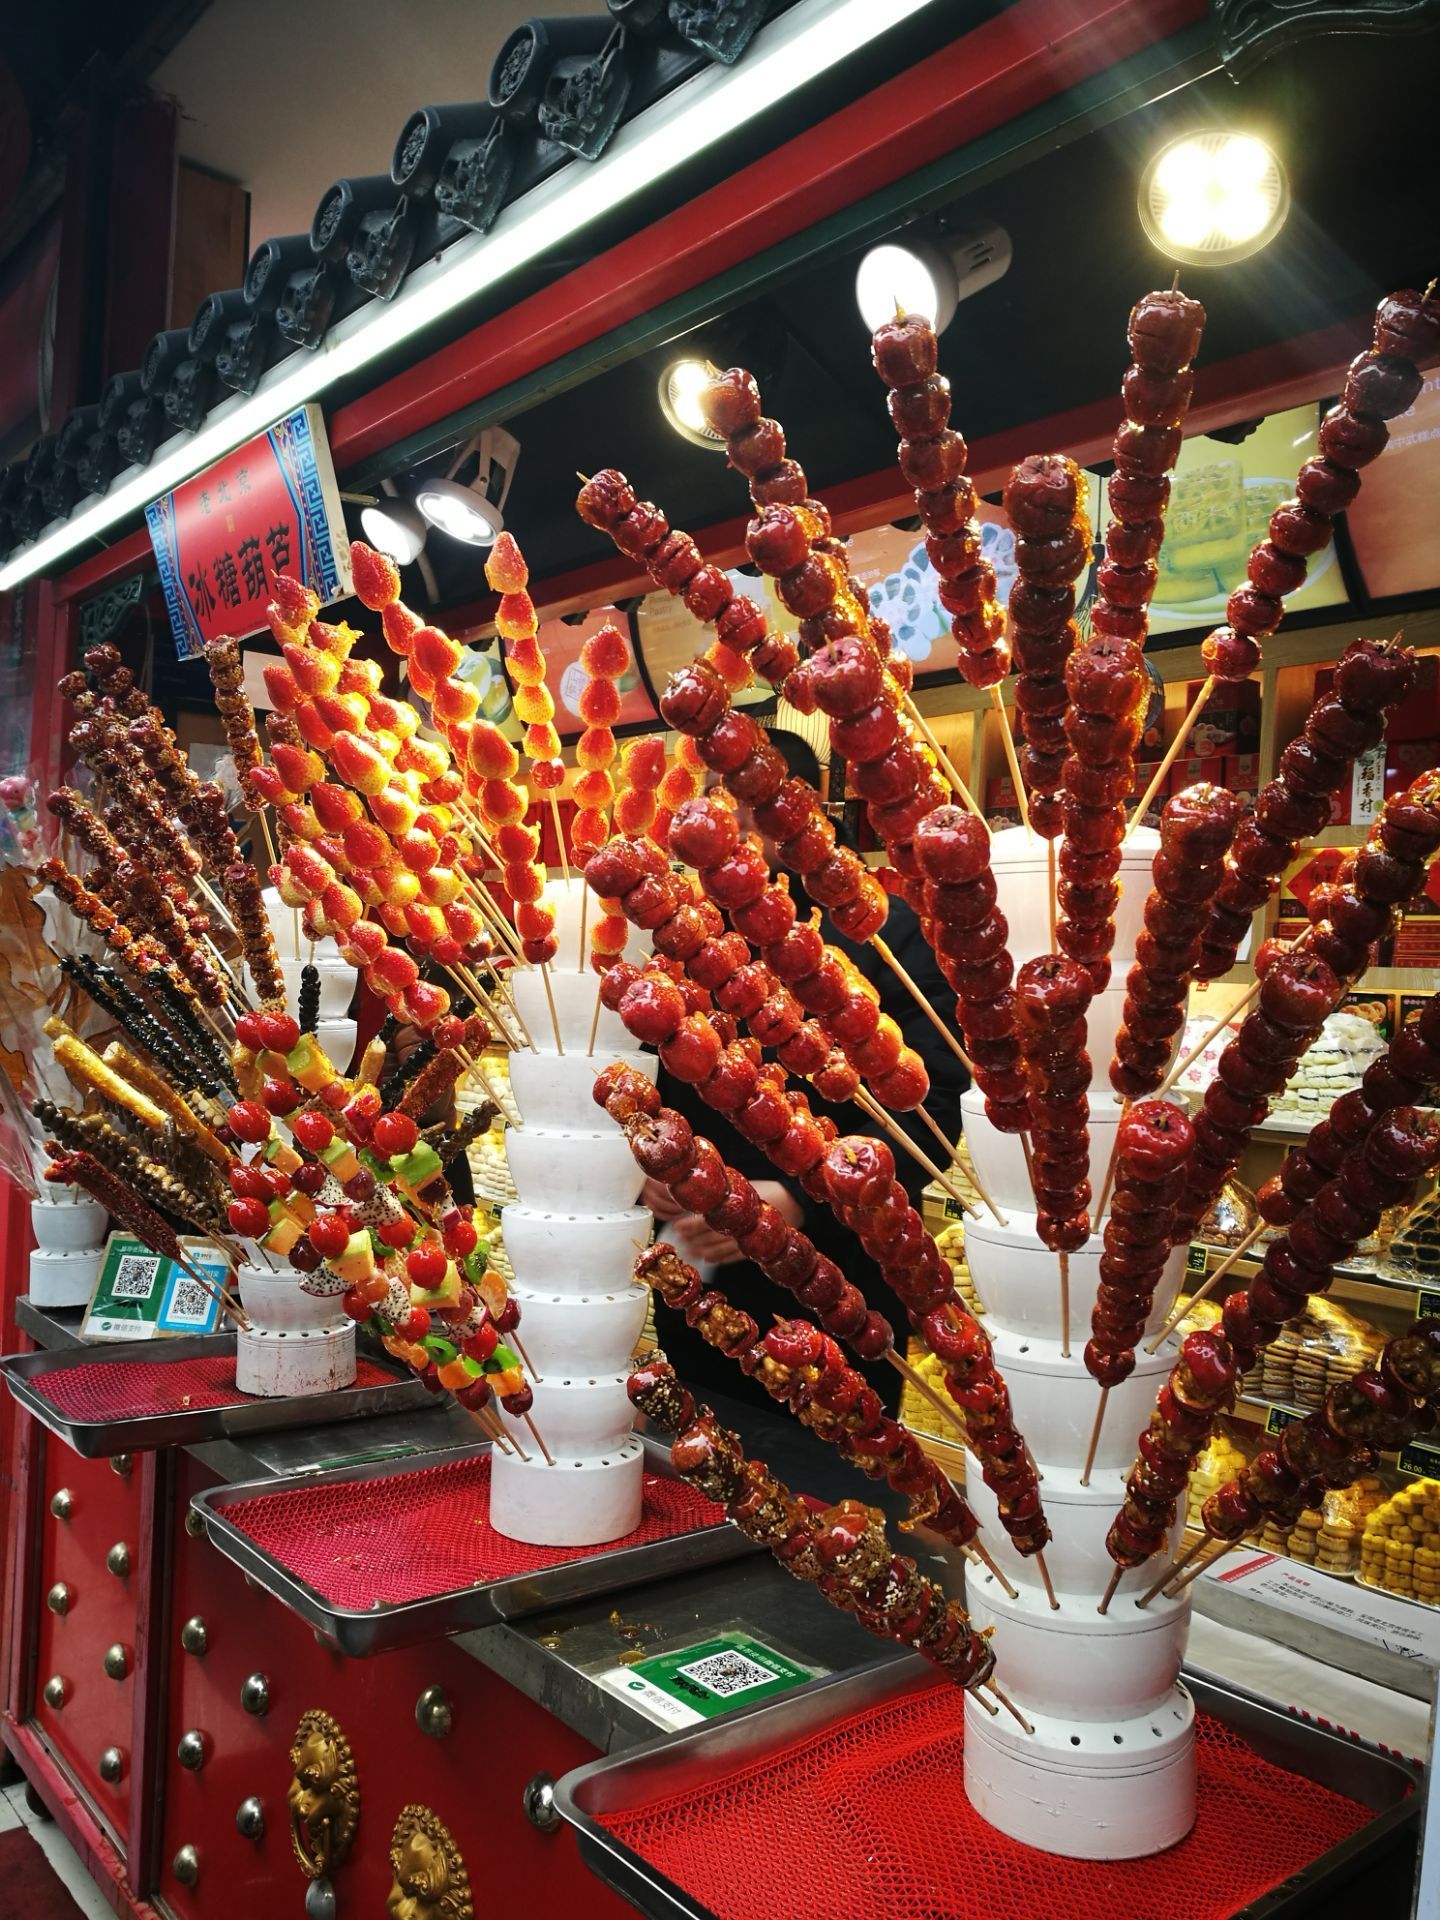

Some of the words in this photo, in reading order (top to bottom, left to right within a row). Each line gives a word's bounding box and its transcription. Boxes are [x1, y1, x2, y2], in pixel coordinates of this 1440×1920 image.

[199, 467, 251, 515] 老北京
[188, 520, 290, 622] 冰糖葫芦
[1403, 1462, 1423, 1474] 26.00
